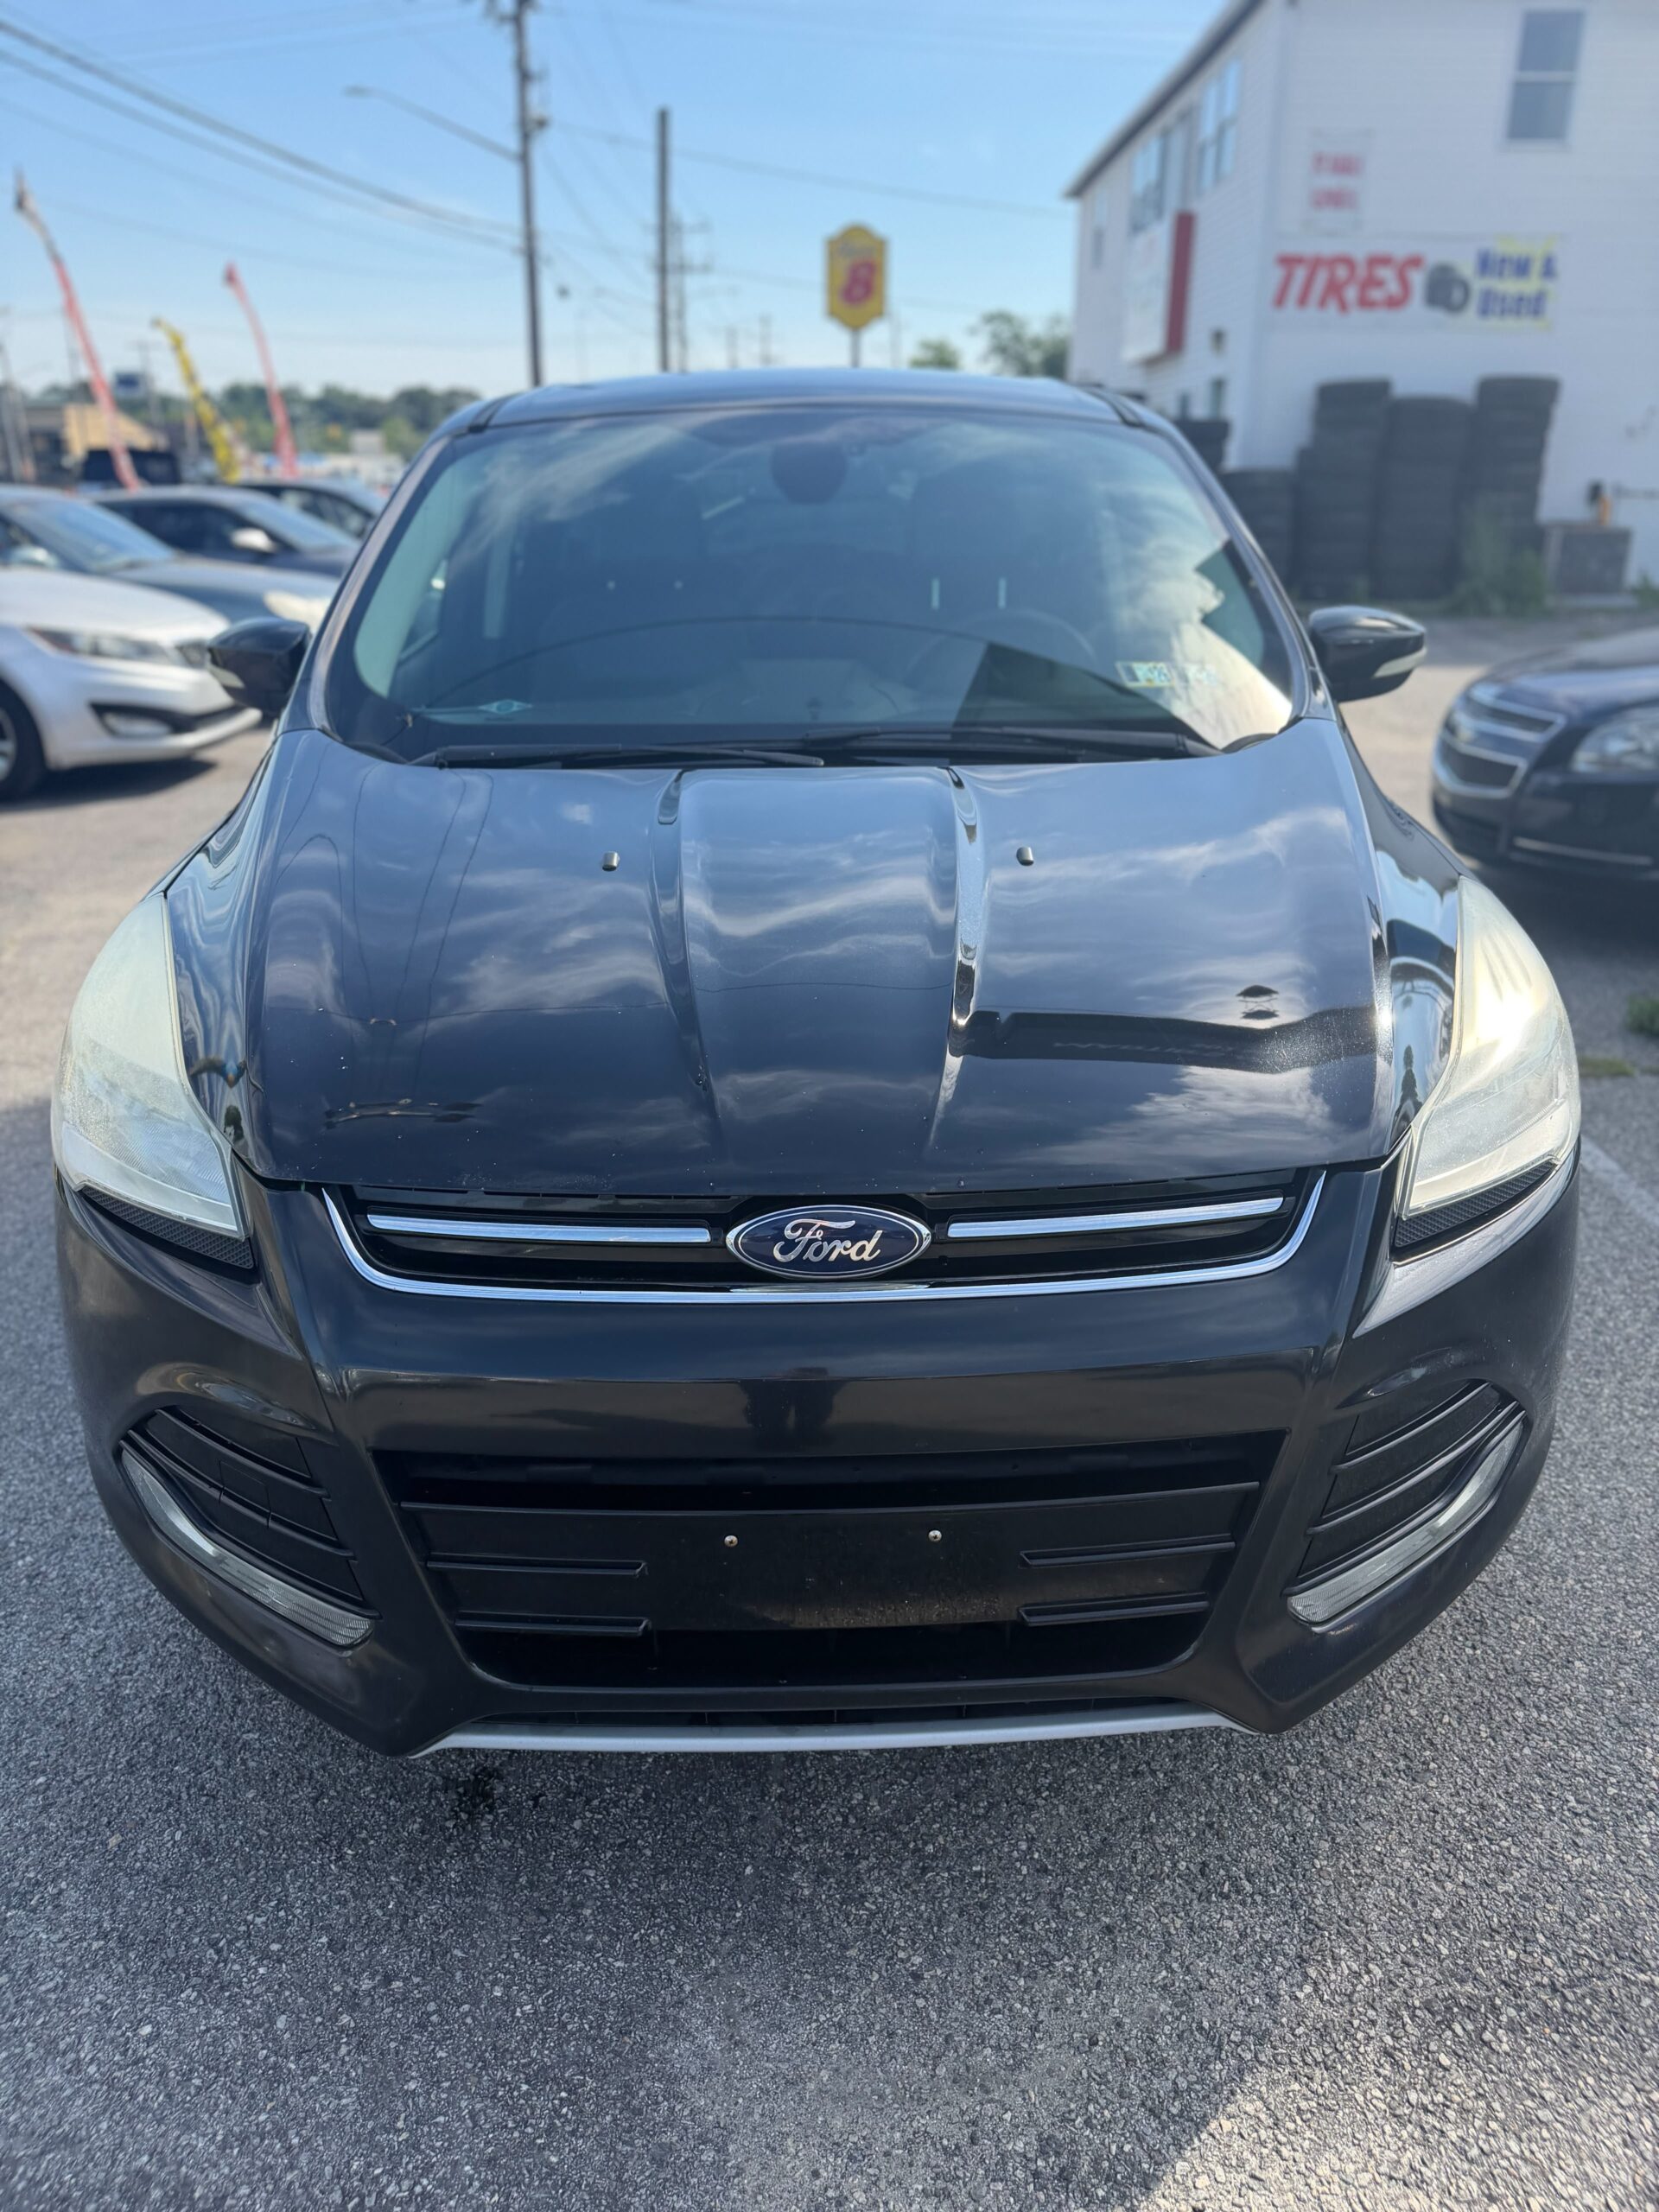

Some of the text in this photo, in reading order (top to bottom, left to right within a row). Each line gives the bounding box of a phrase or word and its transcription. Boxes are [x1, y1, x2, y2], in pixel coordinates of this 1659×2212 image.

[840, 260, 877, 307] 8
[1273, 253, 1425, 315] TIRES
[772, 1218, 882, 1263] Ford
